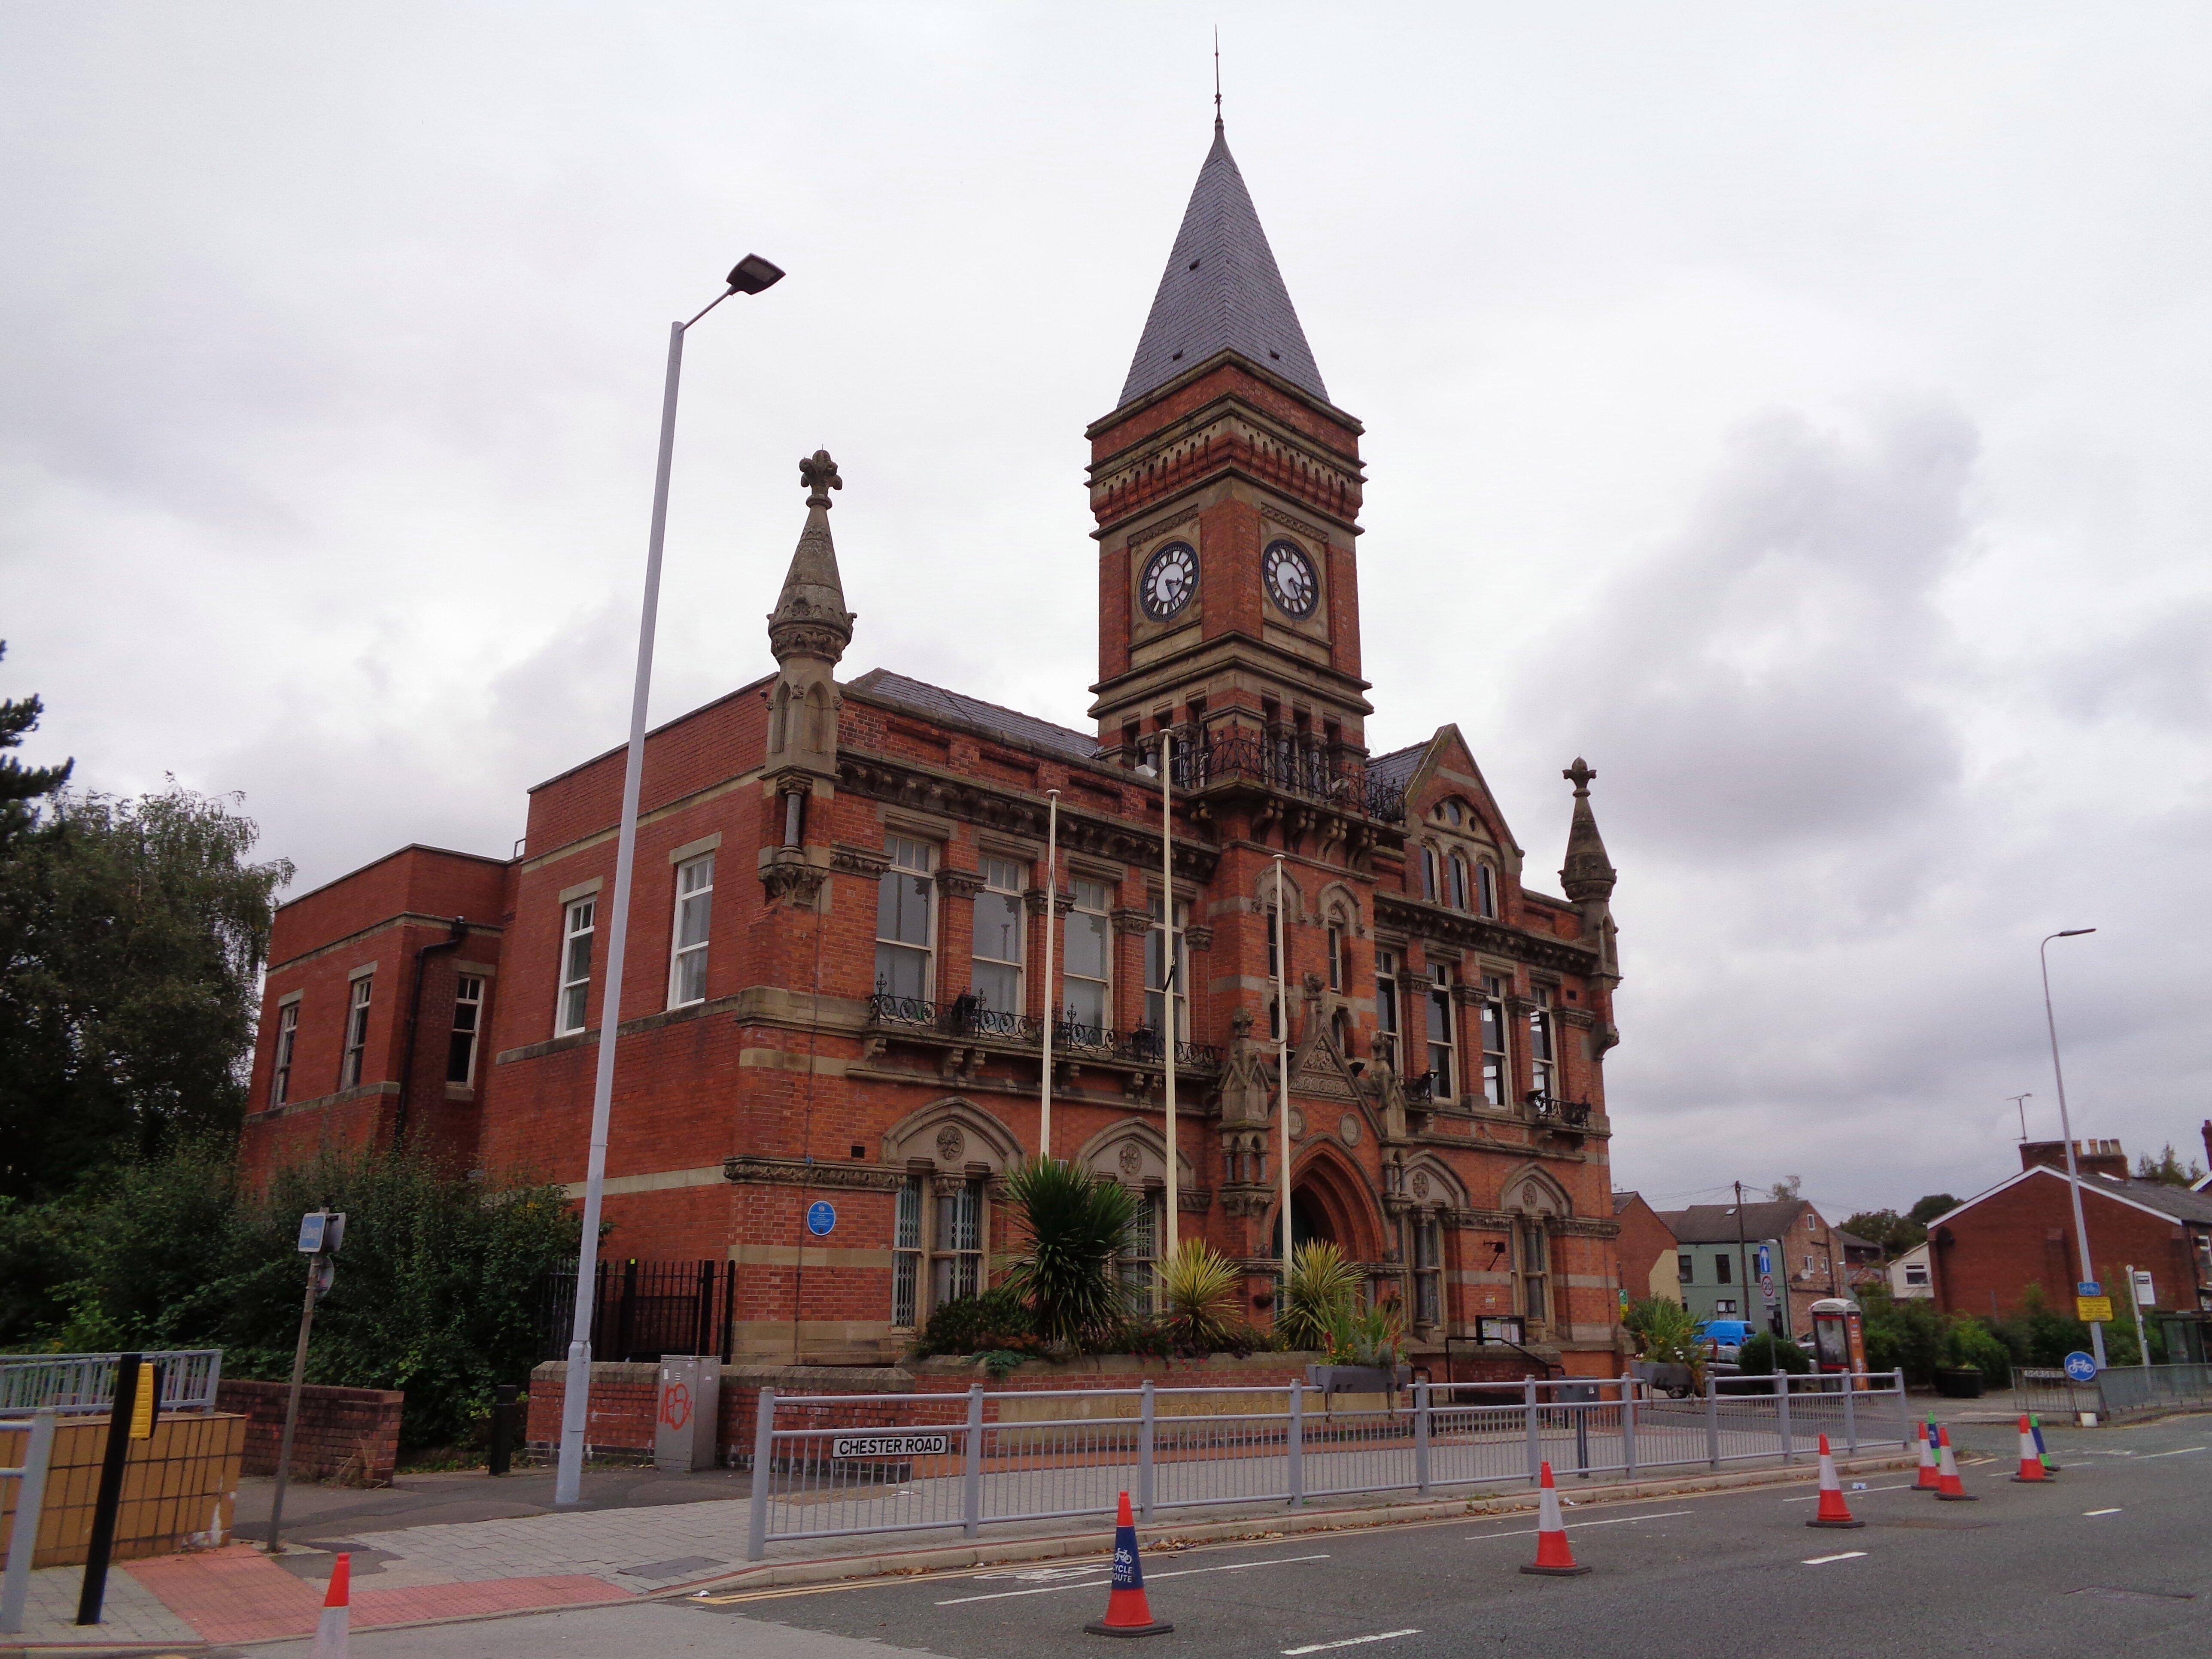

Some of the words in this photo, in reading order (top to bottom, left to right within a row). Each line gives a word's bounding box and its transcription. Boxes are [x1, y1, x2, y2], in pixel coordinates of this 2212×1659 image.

[839, 1438, 902, 1455] CHESTER
[905, 1437, 942, 1452] ROAD
[1113, 1573, 1133, 1583] OUTE
